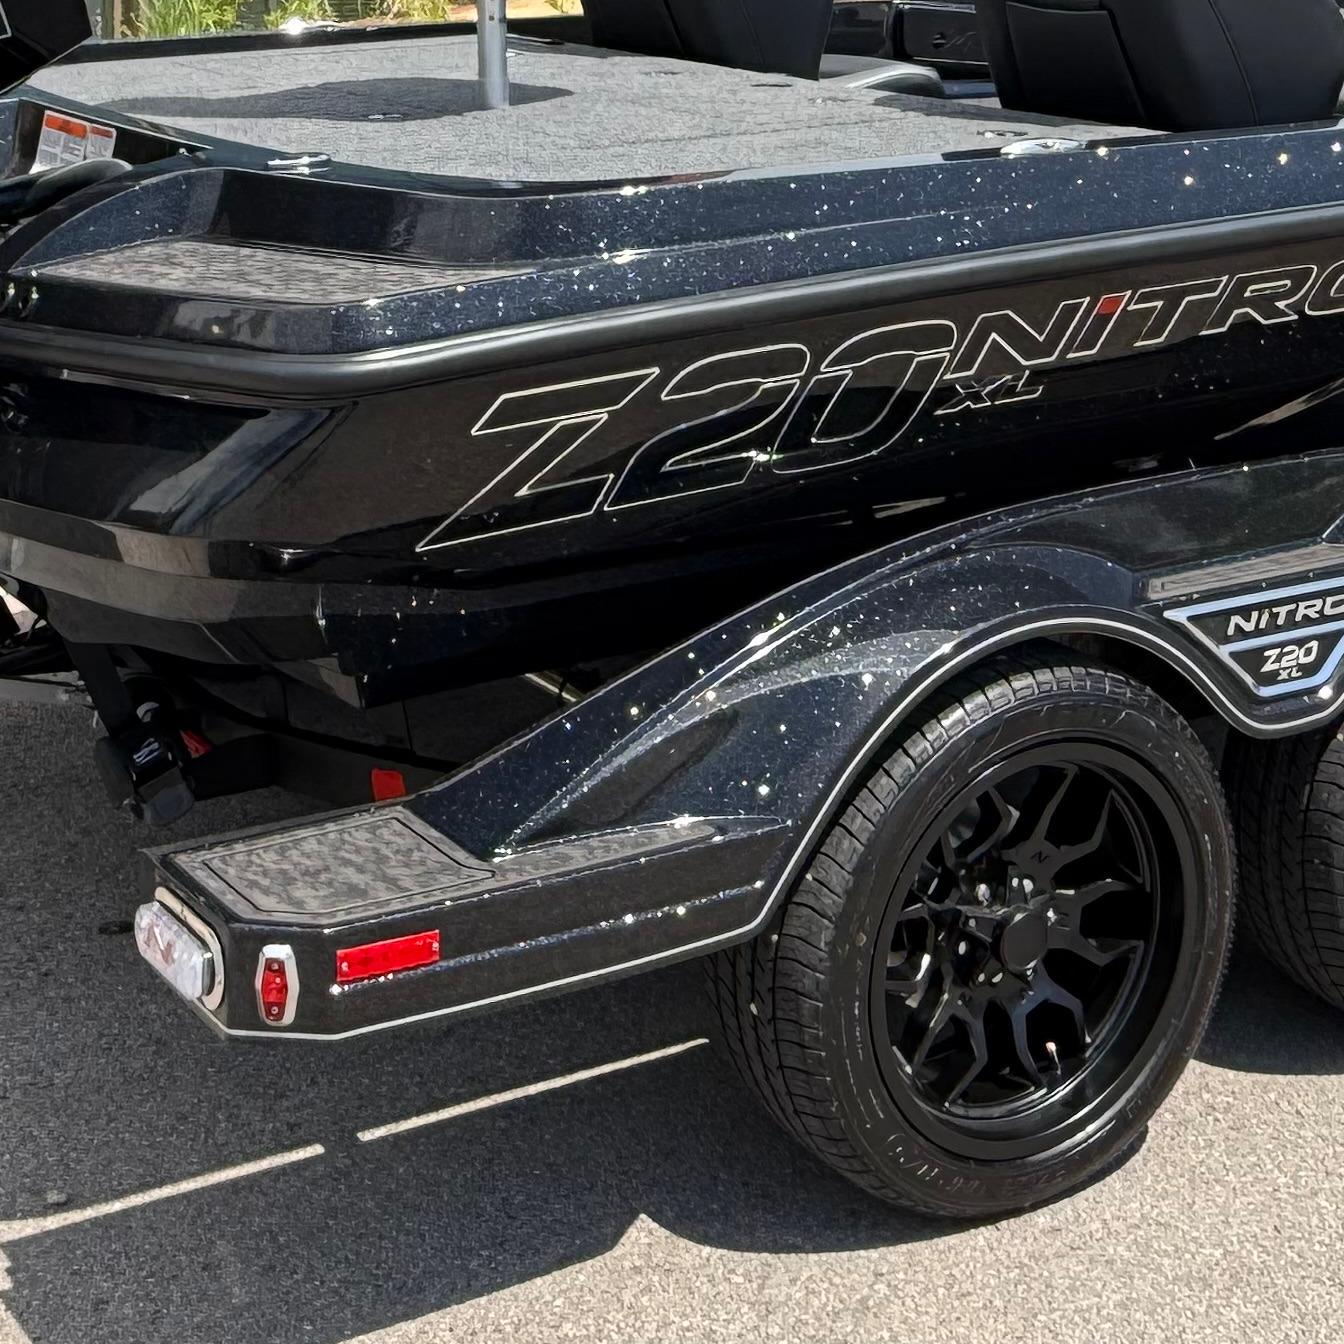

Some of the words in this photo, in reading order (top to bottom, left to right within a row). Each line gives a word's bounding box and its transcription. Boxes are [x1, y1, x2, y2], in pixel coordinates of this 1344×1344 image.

[933, 369, 1045, 416] XL
[415, 319, 958, 552] Z20
[1260, 639, 1320, 673] Z20
[1276, 667, 1303, 681] XL
